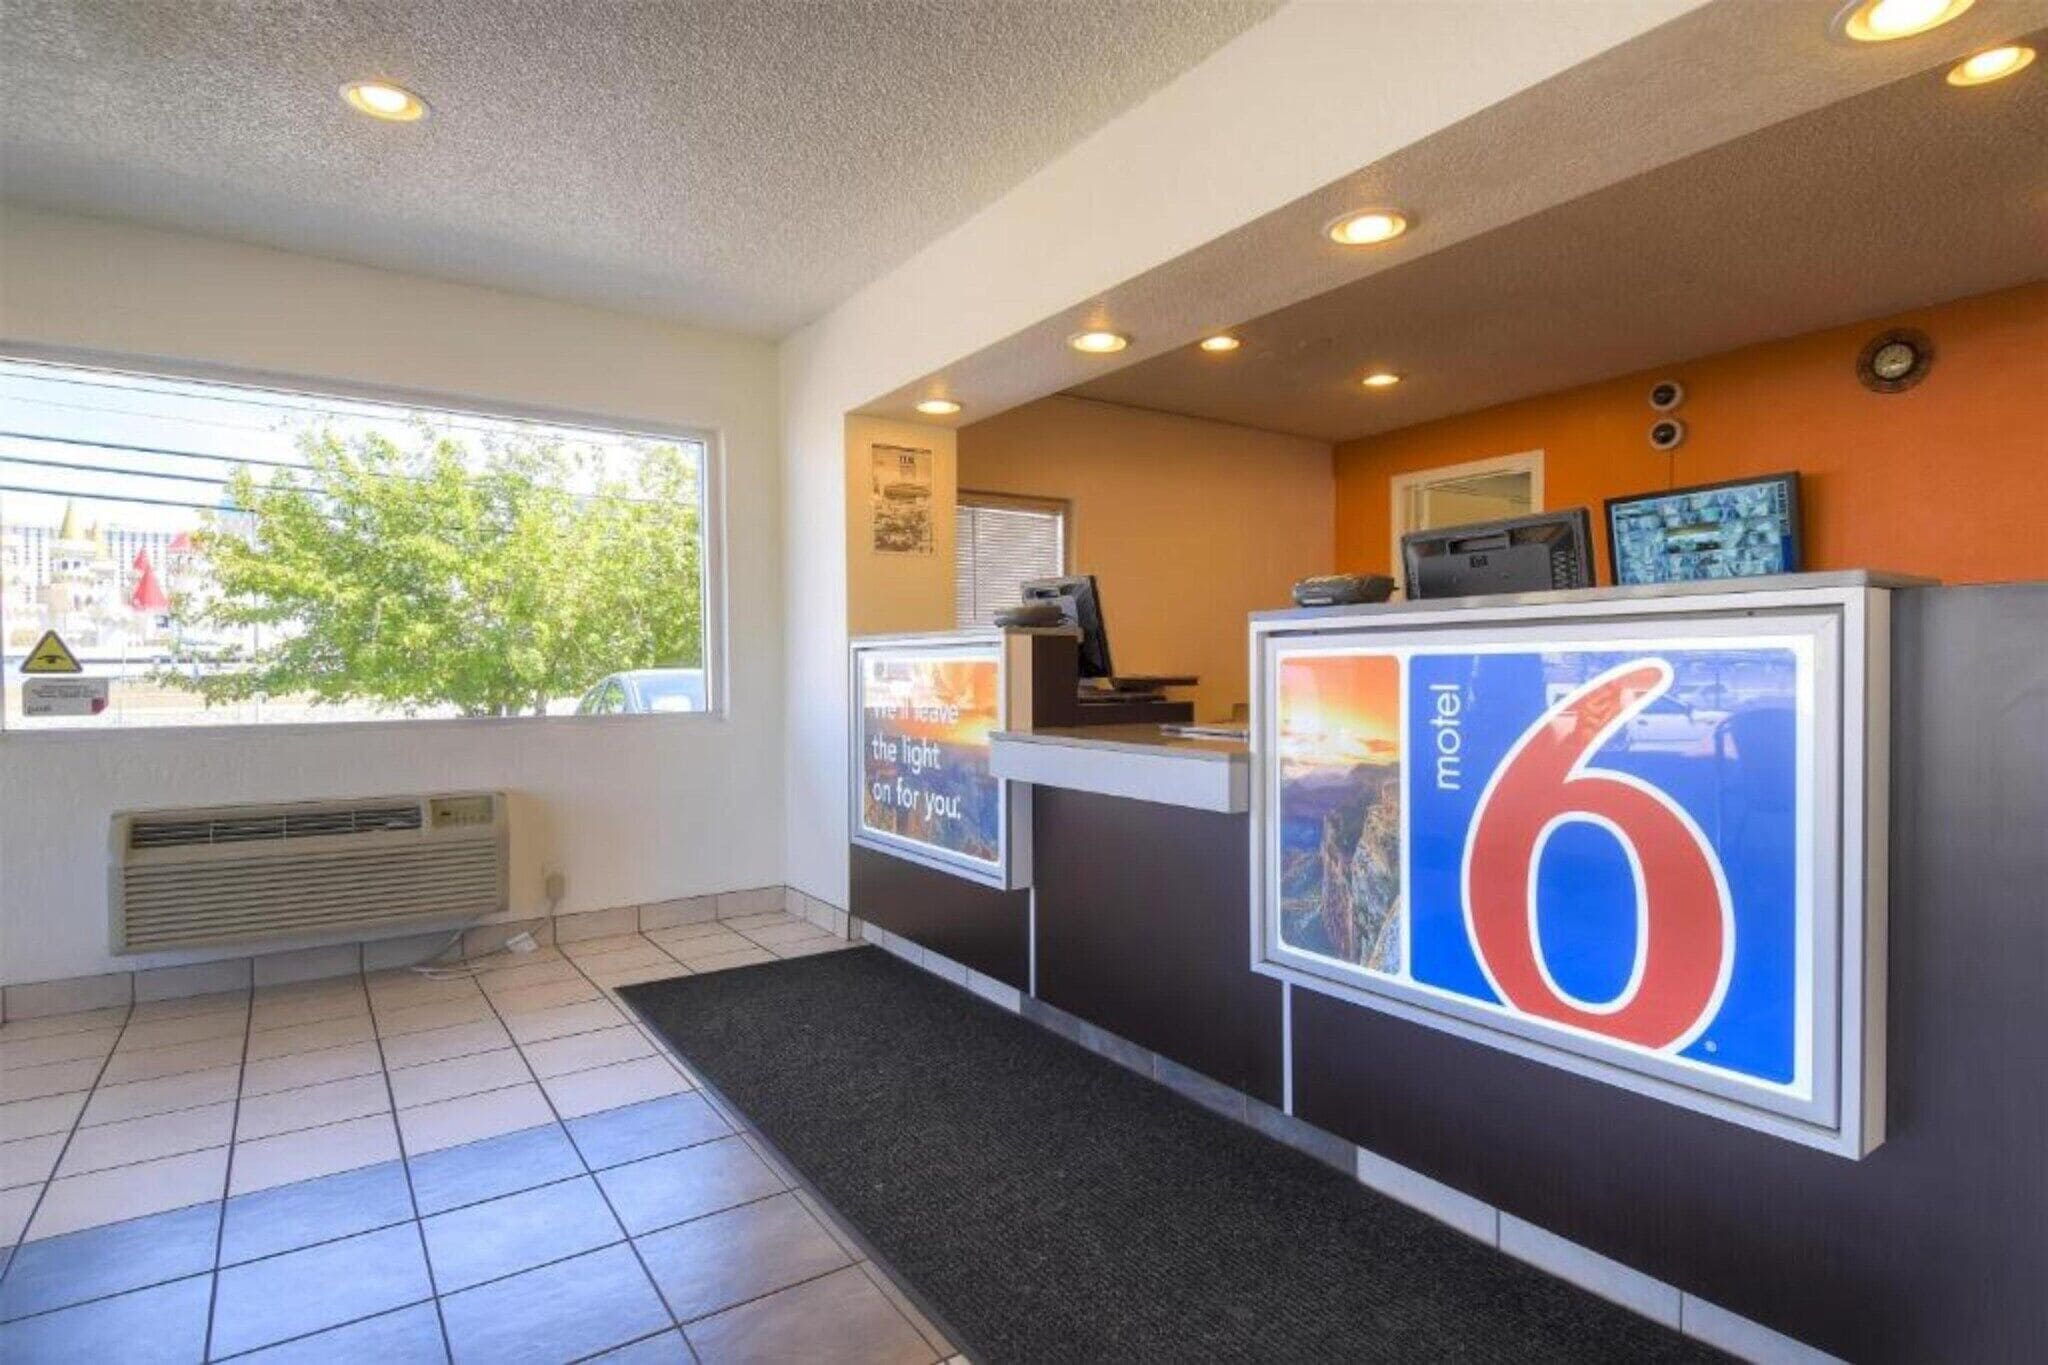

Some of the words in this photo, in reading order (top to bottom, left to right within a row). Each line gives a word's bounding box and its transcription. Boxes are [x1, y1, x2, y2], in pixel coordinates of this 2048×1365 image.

[873, 695, 910, 721] Well
[872, 733, 897, 762] the
[901, 734, 941, 775] light
[1429, 683, 1461, 790] motel
[873, 782, 891, 805] on
[896, 776, 920, 810] for
[1461, 657, 1736, 1056] 6
